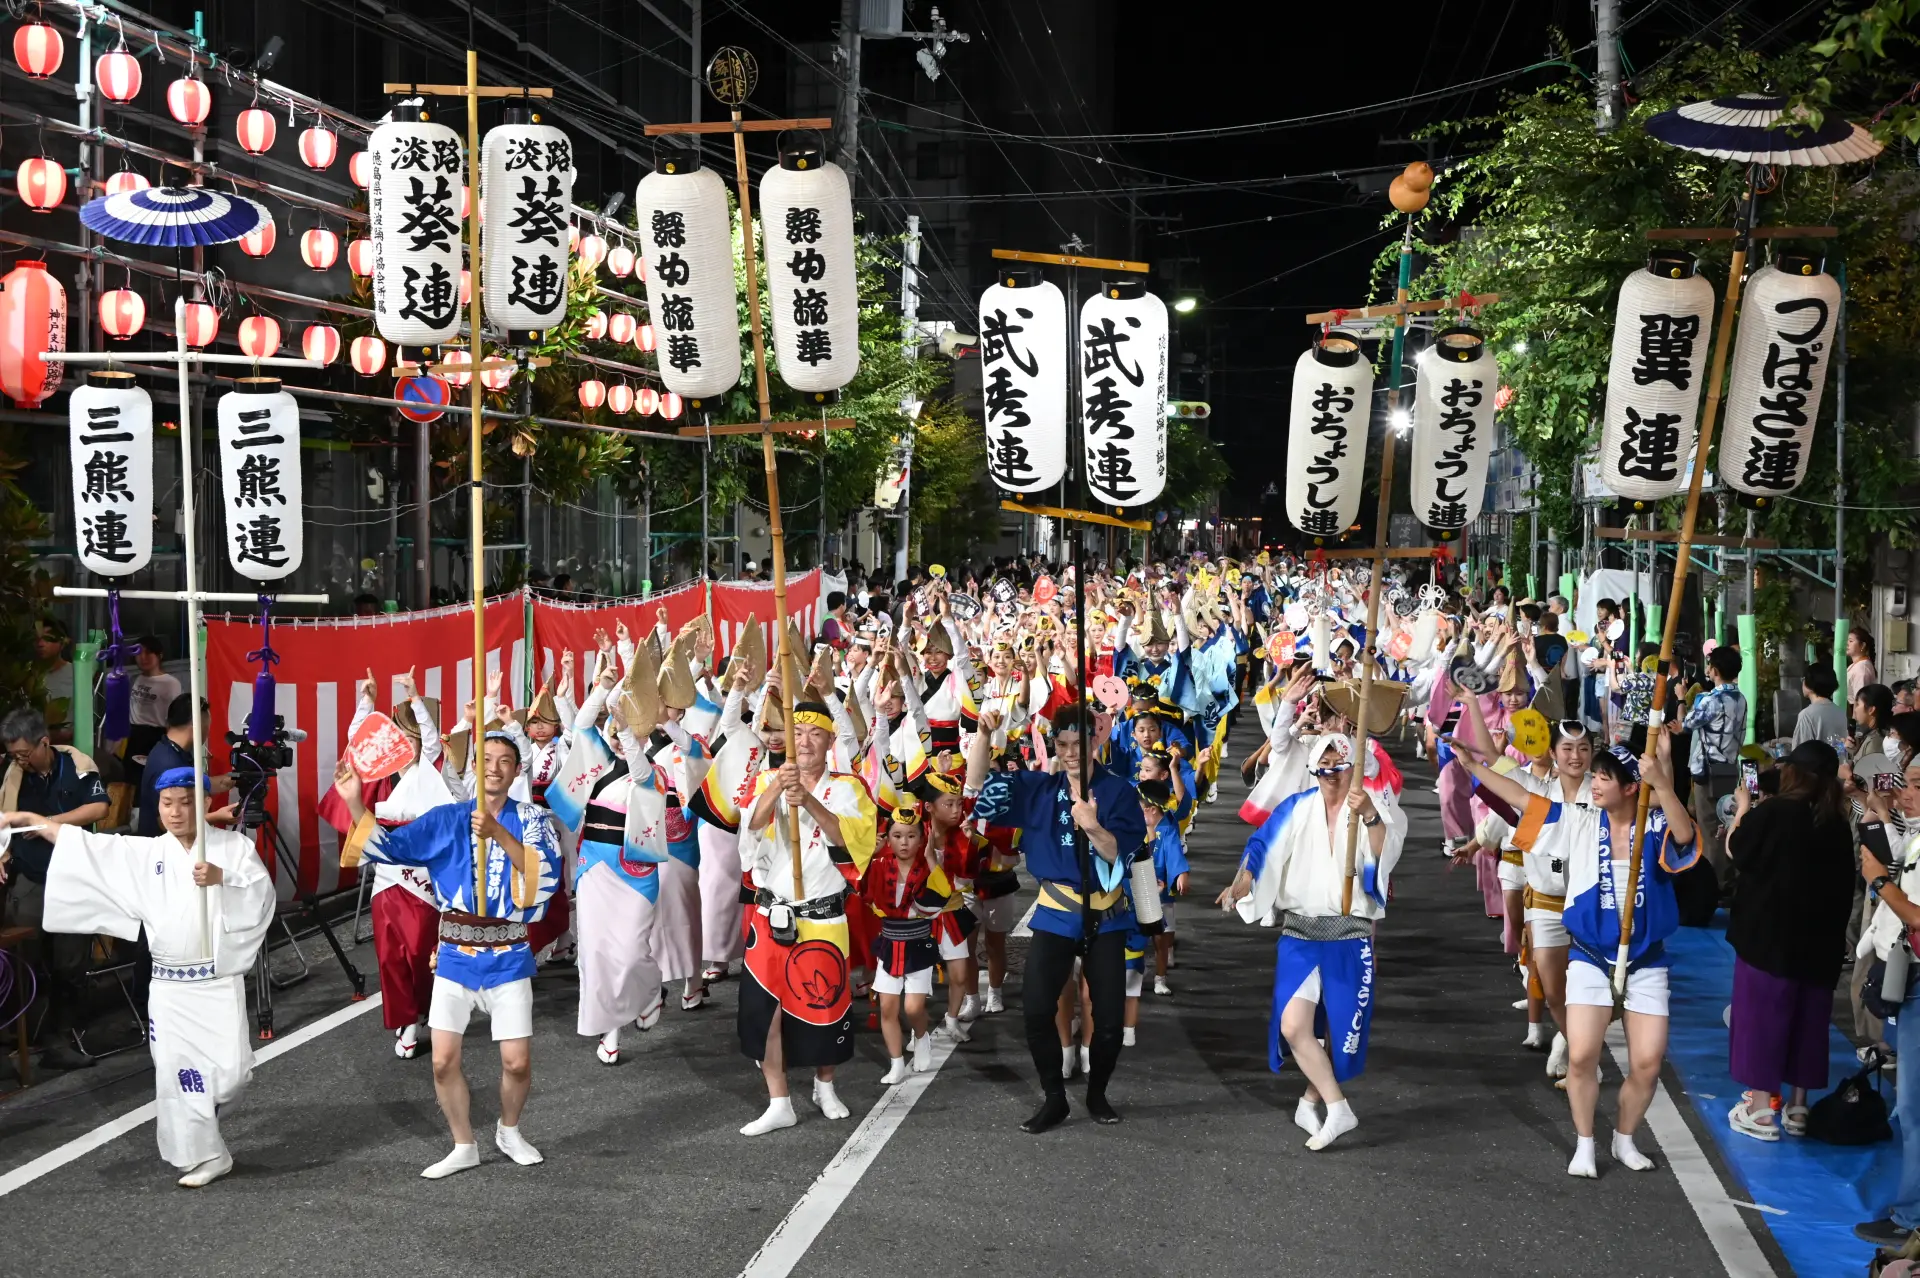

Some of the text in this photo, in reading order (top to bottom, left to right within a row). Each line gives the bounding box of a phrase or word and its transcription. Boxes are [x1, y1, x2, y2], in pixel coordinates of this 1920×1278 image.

[391, 137, 460, 174] 淡路
[505, 138, 570, 173] 淡路
[397, 176, 460, 330] 葵連
[507, 175, 568, 315] 葵連
[981, 308, 1041, 486] 武秀連
[1084, 317, 1145, 501] 武秀連
[1300, 383, 1355, 535] おちょうし連
[1428, 378, 1484, 528] おちょうし連
[1617, 313, 1700, 481] 翼連
[1742, 297, 1829, 490] つばさ連
[79, 405, 137, 564] 三熊連
[230, 408, 290, 568] 三熊連
[1057, 789, 1074, 846] 武秀連
